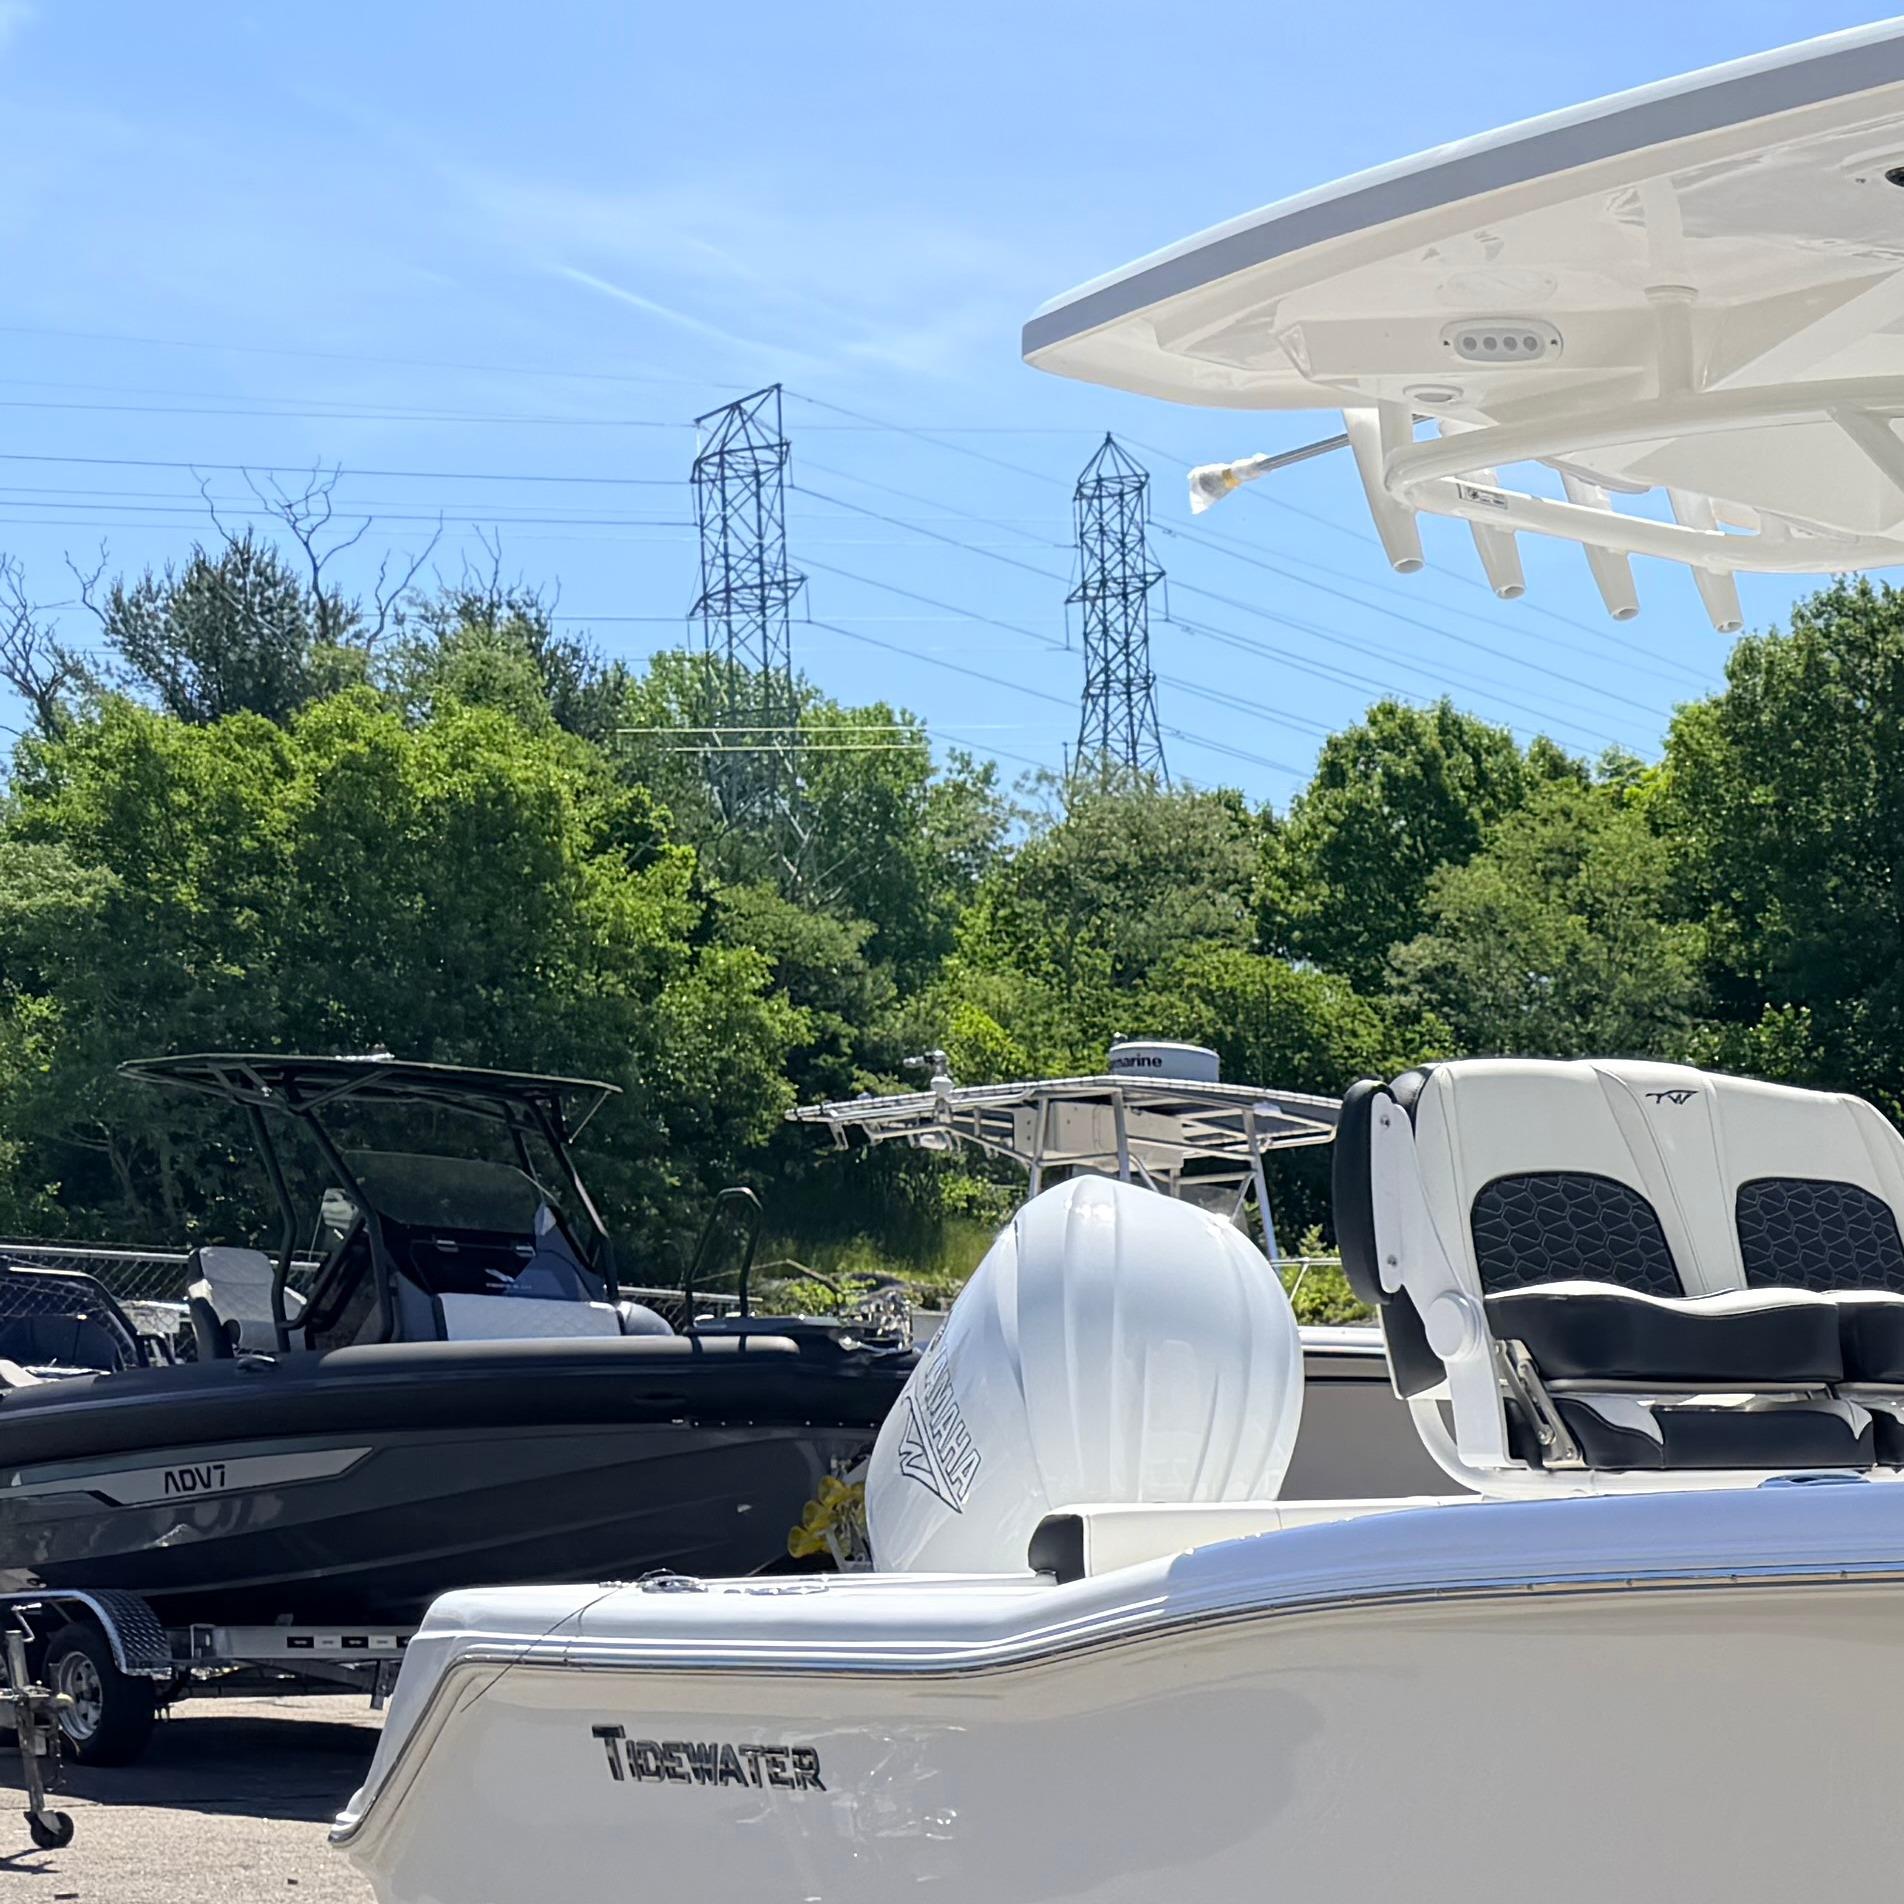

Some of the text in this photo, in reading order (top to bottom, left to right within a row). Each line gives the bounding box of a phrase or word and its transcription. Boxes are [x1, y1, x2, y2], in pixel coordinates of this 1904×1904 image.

[924, 1345, 981, 1502] AMAHA
[164, 1464, 225, 1495] ADV7
[591, 1723, 827, 1792] TIDEWATER
